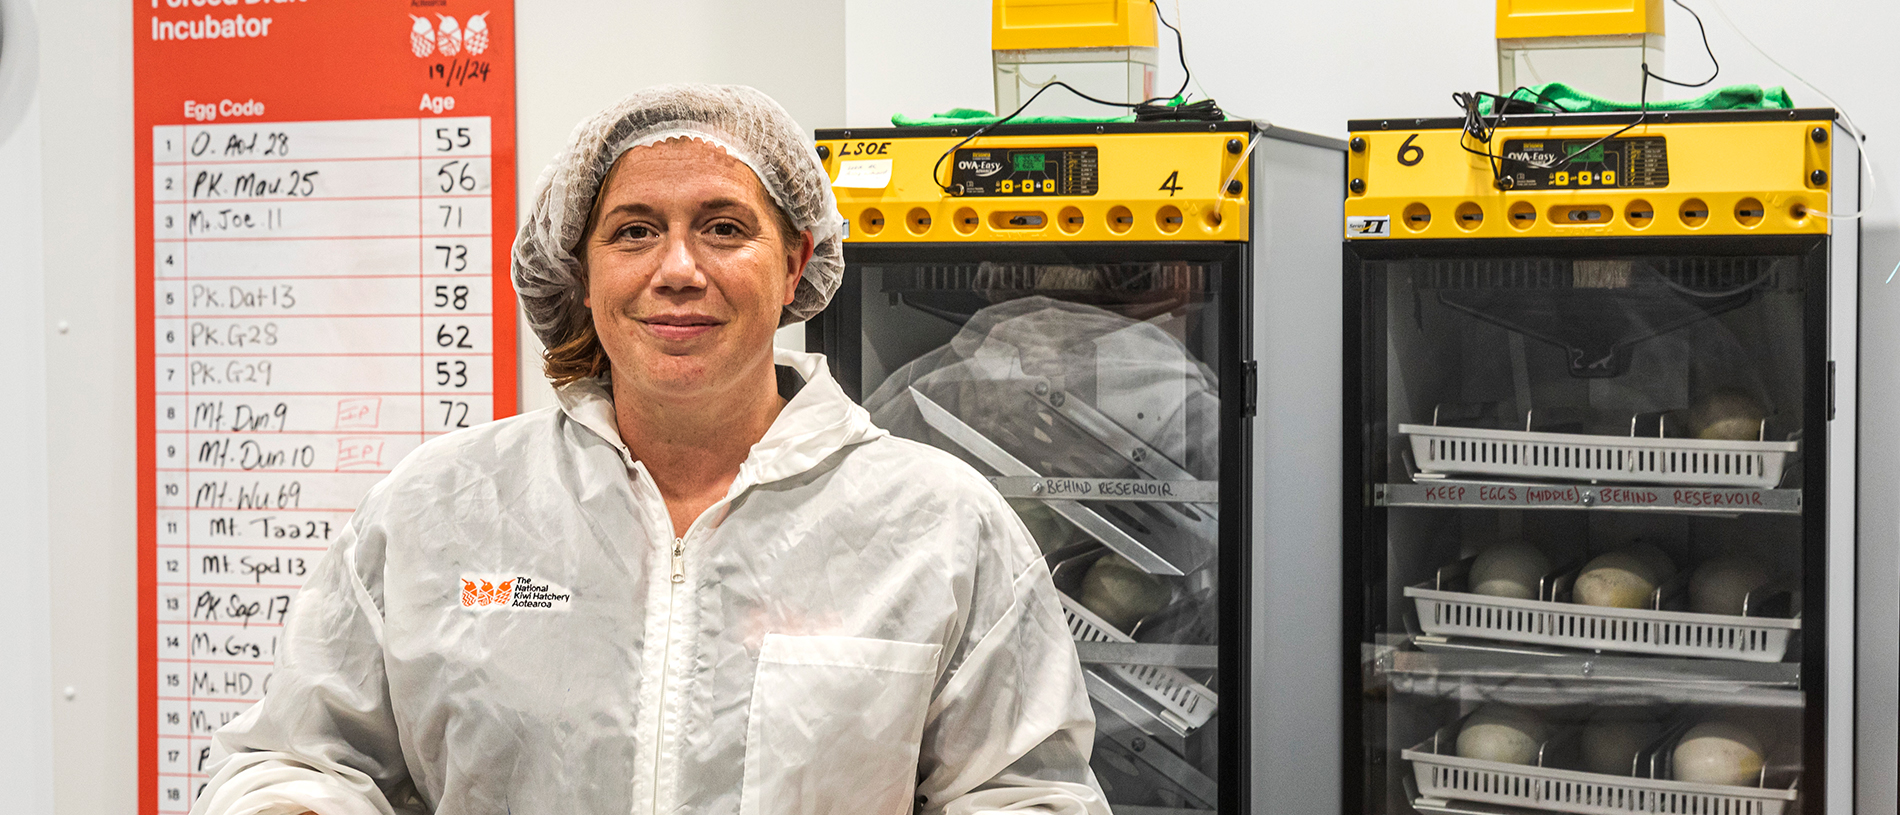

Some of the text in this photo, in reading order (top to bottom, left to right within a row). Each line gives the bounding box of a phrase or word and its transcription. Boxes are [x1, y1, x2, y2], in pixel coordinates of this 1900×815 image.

[151, 13, 273, 41] Incubator
[428, 59, 491, 87] 19/1/24
[419, 93, 455, 112] Age
[184, 99, 265, 121] Egg Code
[166, 140, 171, 150] 1
[436, 128, 471, 152] 55
[1396, 133, 1425, 167] 6
[437, 161, 476, 194] 56
[165, 178, 173, 190] 2
[1157, 170, 1185, 198] 4
[165, 216, 174, 228] 3
[439, 205, 462, 228] 71
[165, 254, 174, 265] 4
[435, 244, 468, 272] 73
[165, 293, 174, 304] 5
[434, 285, 469, 311] 58
[166, 331, 175, 342] 6
[437, 324, 473, 349] 62
[168, 369, 175, 380] 7
[436, 360, 468, 388] 53
[167, 408, 175, 419] 8
[439, 400, 470, 428] 72
[167, 446, 176, 457] 9
[164, 484, 178, 495] 10
[1046, 478, 1092, 496] BEHIND
[1425, 486, 1466, 501] KEEP
[1479, 486, 1518, 501] EGGS
[1525, 486, 1581, 503] (MIDDLE)
[1599, 487, 1659, 504] BEHIND
[167, 522, 178, 532] 11
[166, 560, 179, 572] 12
[516, 576, 532, 585] The
[514, 584, 549, 592] National
[513, 591, 571, 602] Kiwi Hatchery
[166, 599, 179, 610] 13
[511, 599, 552, 608] Aotearoa
[166, 637, 179, 648] 14
[166, 675, 179, 686] 15
[166, 712, 180, 724] 16
[168, 750, 180, 762] 17
[167, 788, 180, 801] 18
